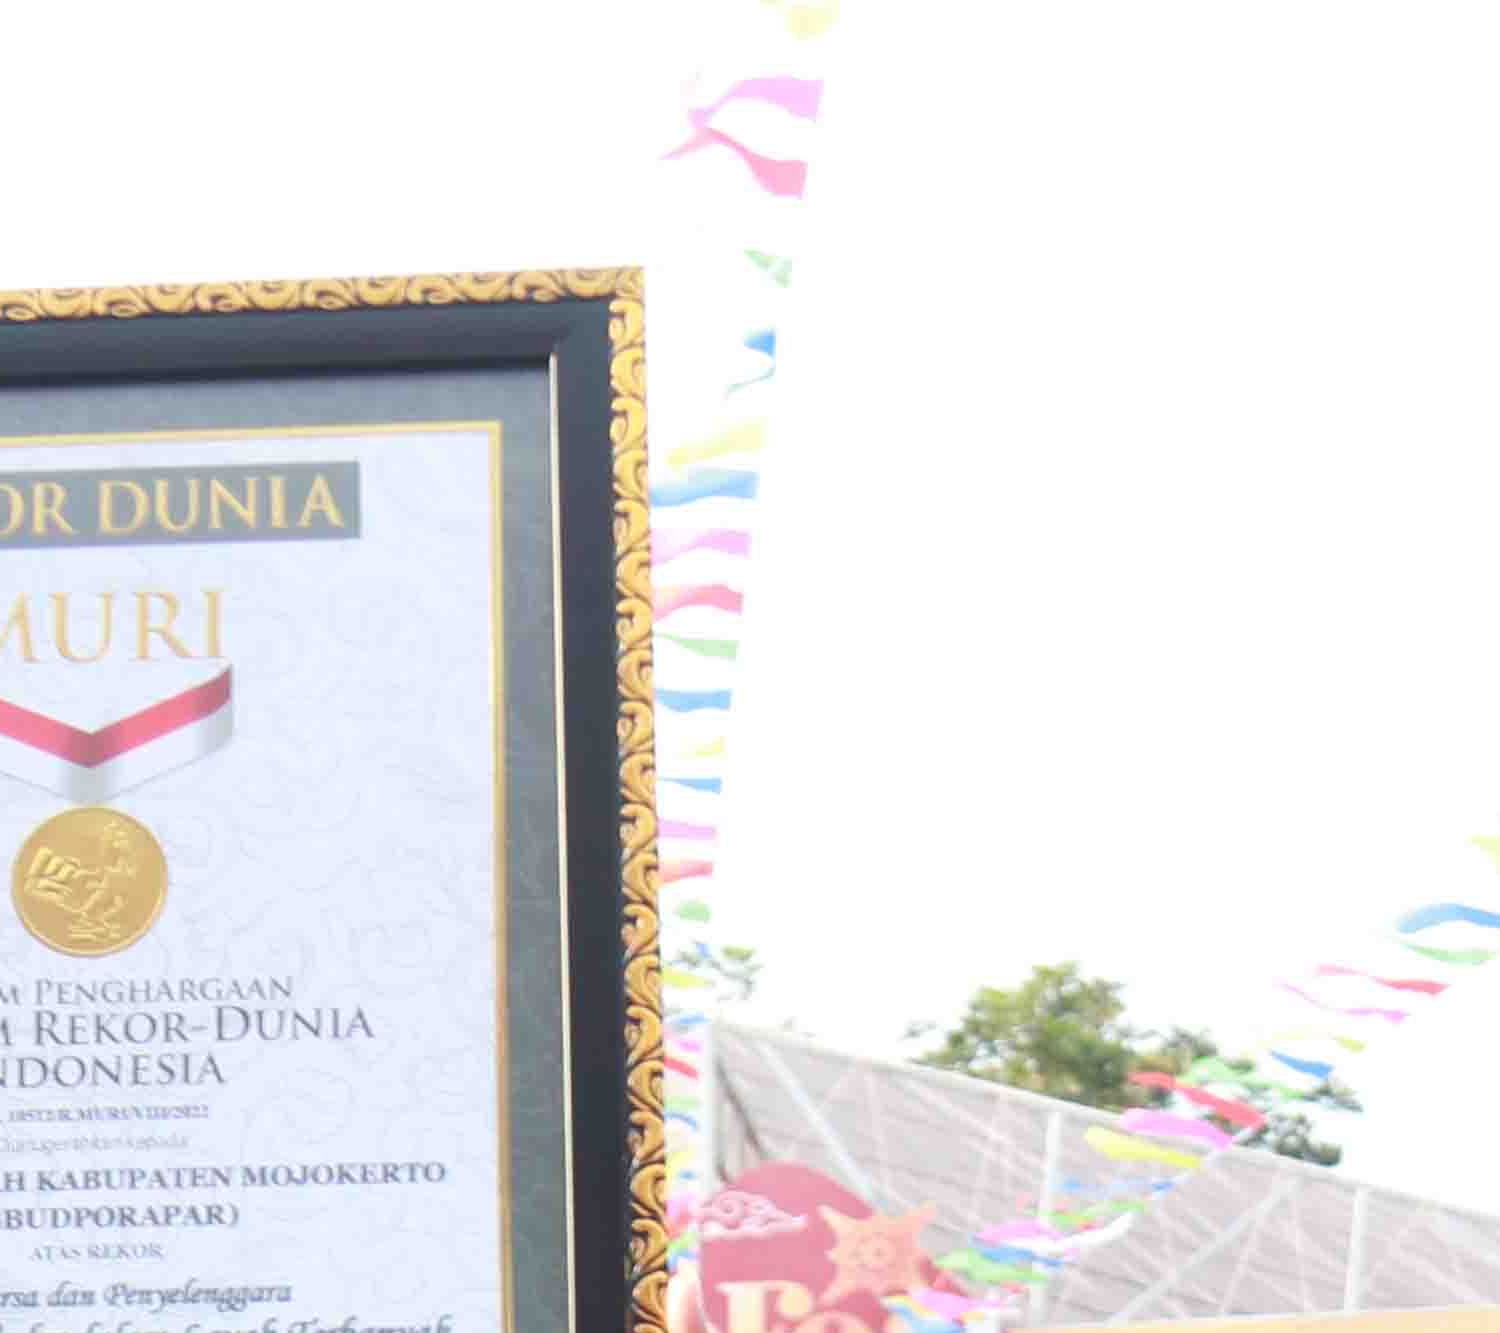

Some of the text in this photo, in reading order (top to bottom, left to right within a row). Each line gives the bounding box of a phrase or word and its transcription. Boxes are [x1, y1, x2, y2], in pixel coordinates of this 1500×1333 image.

[98, 475, 346, 534] DUNIA
[36, 1165, 234, 1193] KABUPATEN
[240, 1160, 447, 1188] MOJOKERTO
[47, 1280, 96, 1307] dan
[103, 1278, 293, 1313] Penyelenggara
